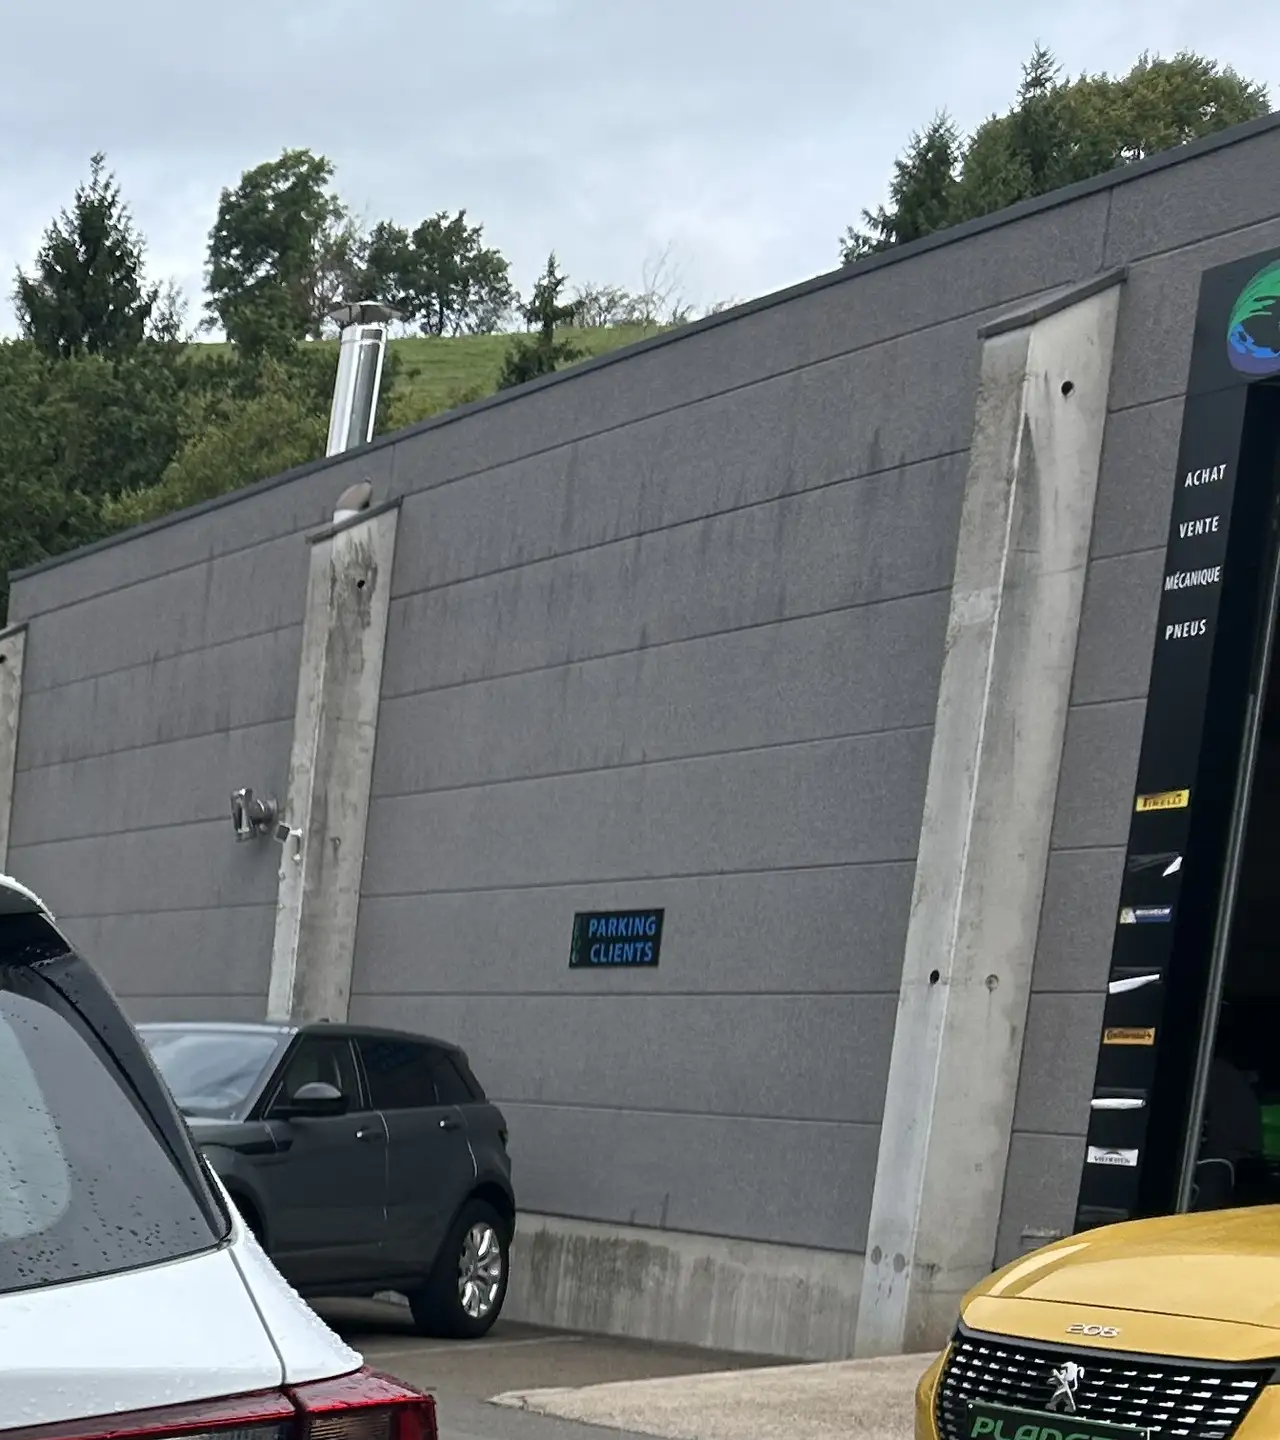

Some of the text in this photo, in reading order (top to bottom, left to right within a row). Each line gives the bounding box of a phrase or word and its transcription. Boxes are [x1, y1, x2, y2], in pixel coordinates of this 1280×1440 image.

[1184, 464, 1227, 488] ACHAT
[1179, 515, 1220, 539] VENTE
[1164, 566, 1222, 592] MÉCANIQUE
[1165, 619, 1207, 641] PNEUS
[588, 915, 656, 938] PARKING
[590, 941, 653, 963] CLIENTS
[1065, 1323, 1120, 1339] 208
